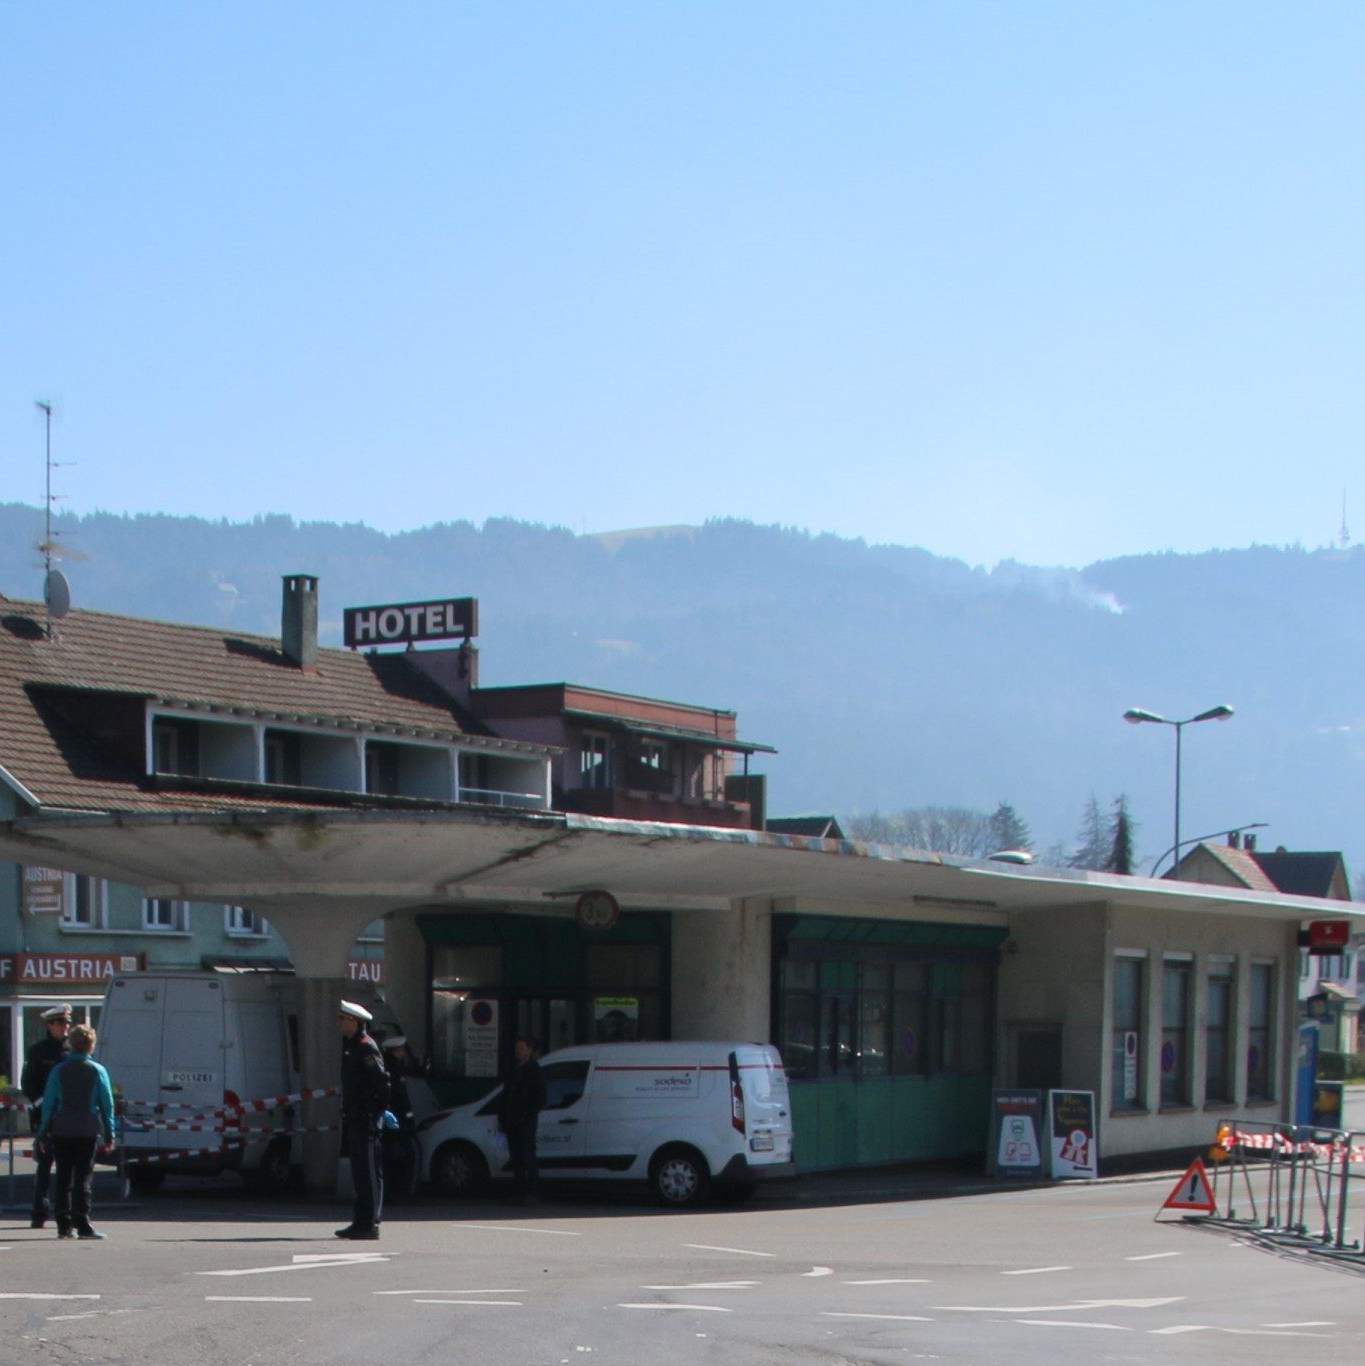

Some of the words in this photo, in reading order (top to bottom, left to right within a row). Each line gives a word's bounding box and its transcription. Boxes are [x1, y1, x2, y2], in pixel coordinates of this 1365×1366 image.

[354, 603, 464, 640] HOTEL
[22, 958, 114, 979] AUSTRIA
[172, 1073, 213, 1082] POLIZEI
